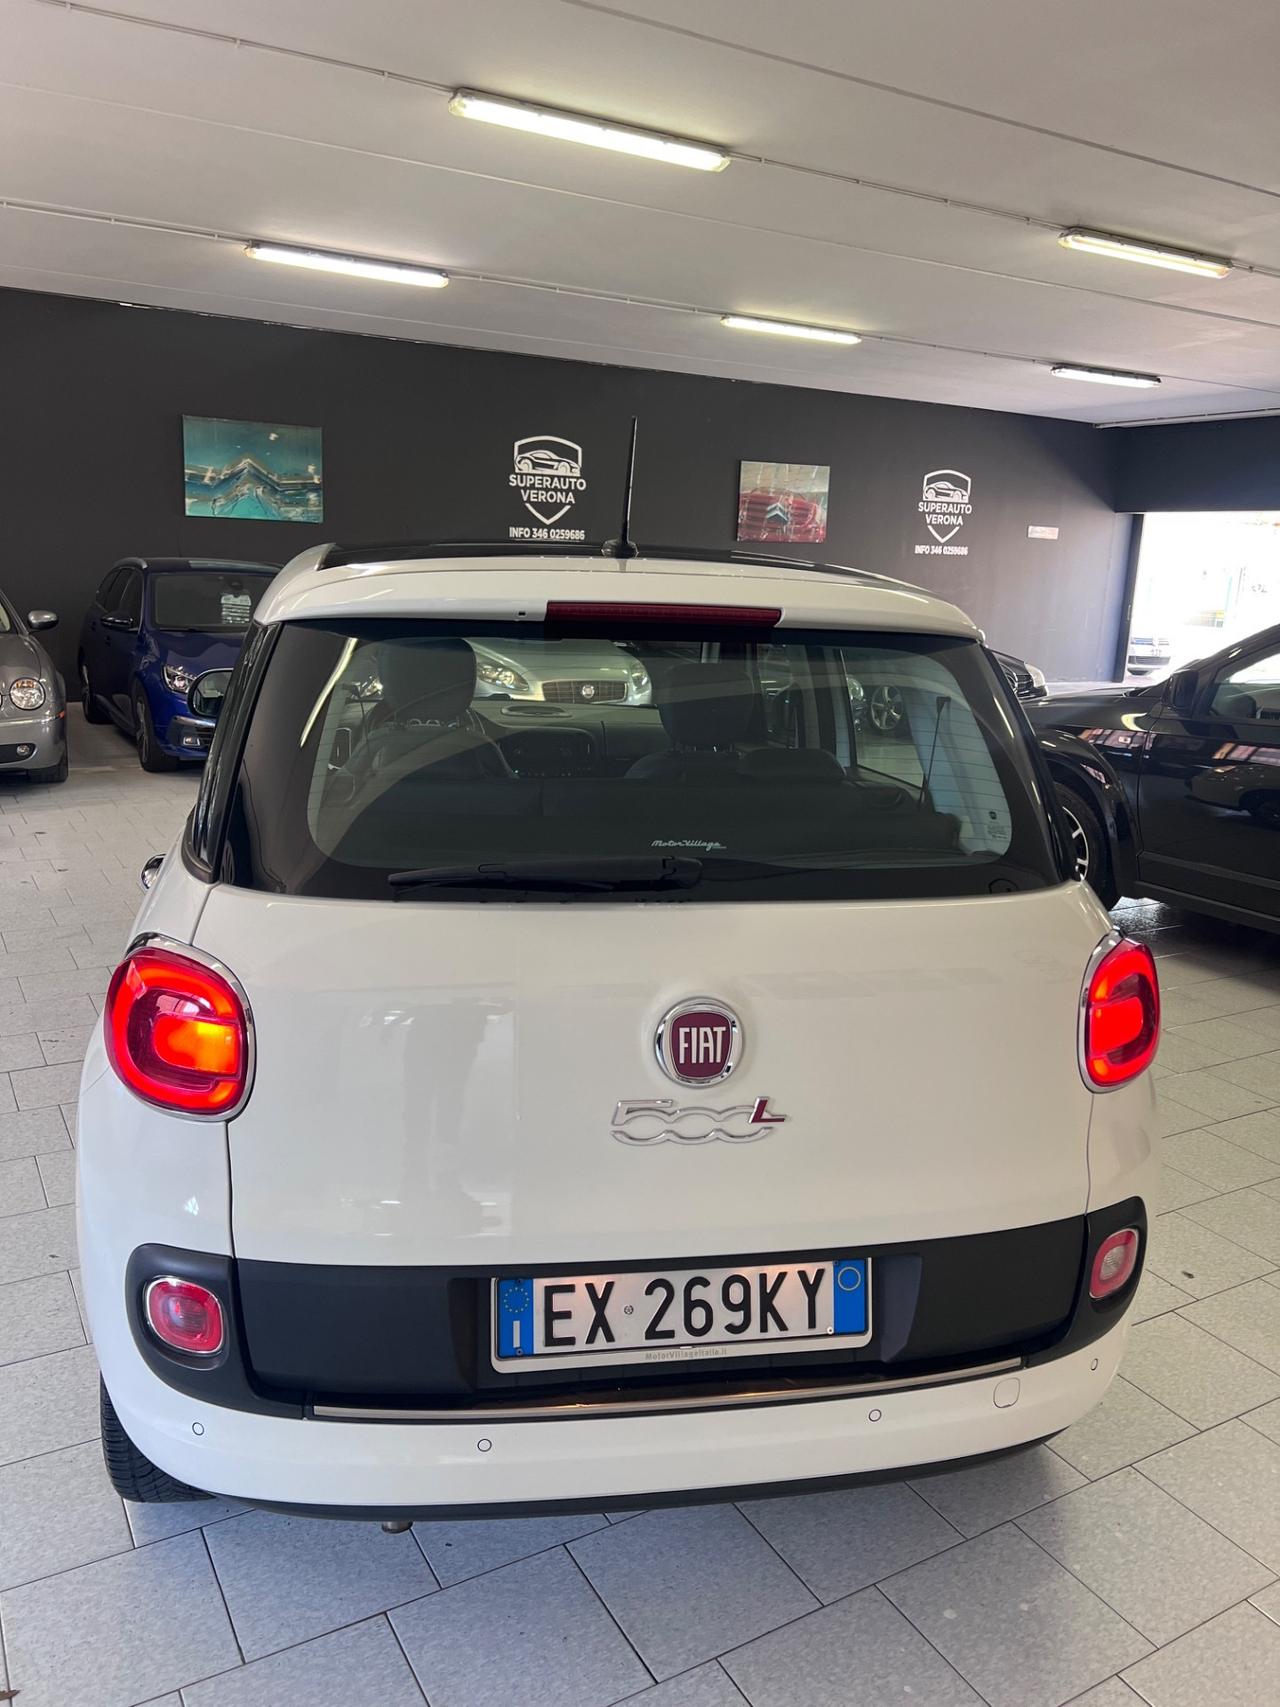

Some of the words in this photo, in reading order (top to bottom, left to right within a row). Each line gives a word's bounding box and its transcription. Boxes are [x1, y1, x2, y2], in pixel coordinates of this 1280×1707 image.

[509, 474, 587, 491] SUPERAUTO
[521, 489, 576, 504] VERONA
[918, 501, 973, 515] SUPERAUTO
[925, 513, 964, 526] VERONA
[509, 526, 531, 538] INFO
[532, 527, 549, 539] 346
[678, 1026, 727, 1064] FIAT
[611, 1096, 788, 1147] 500L
[544, 1280, 616, 1348] EX
[644, 1267, 826, 1341] 269KY
